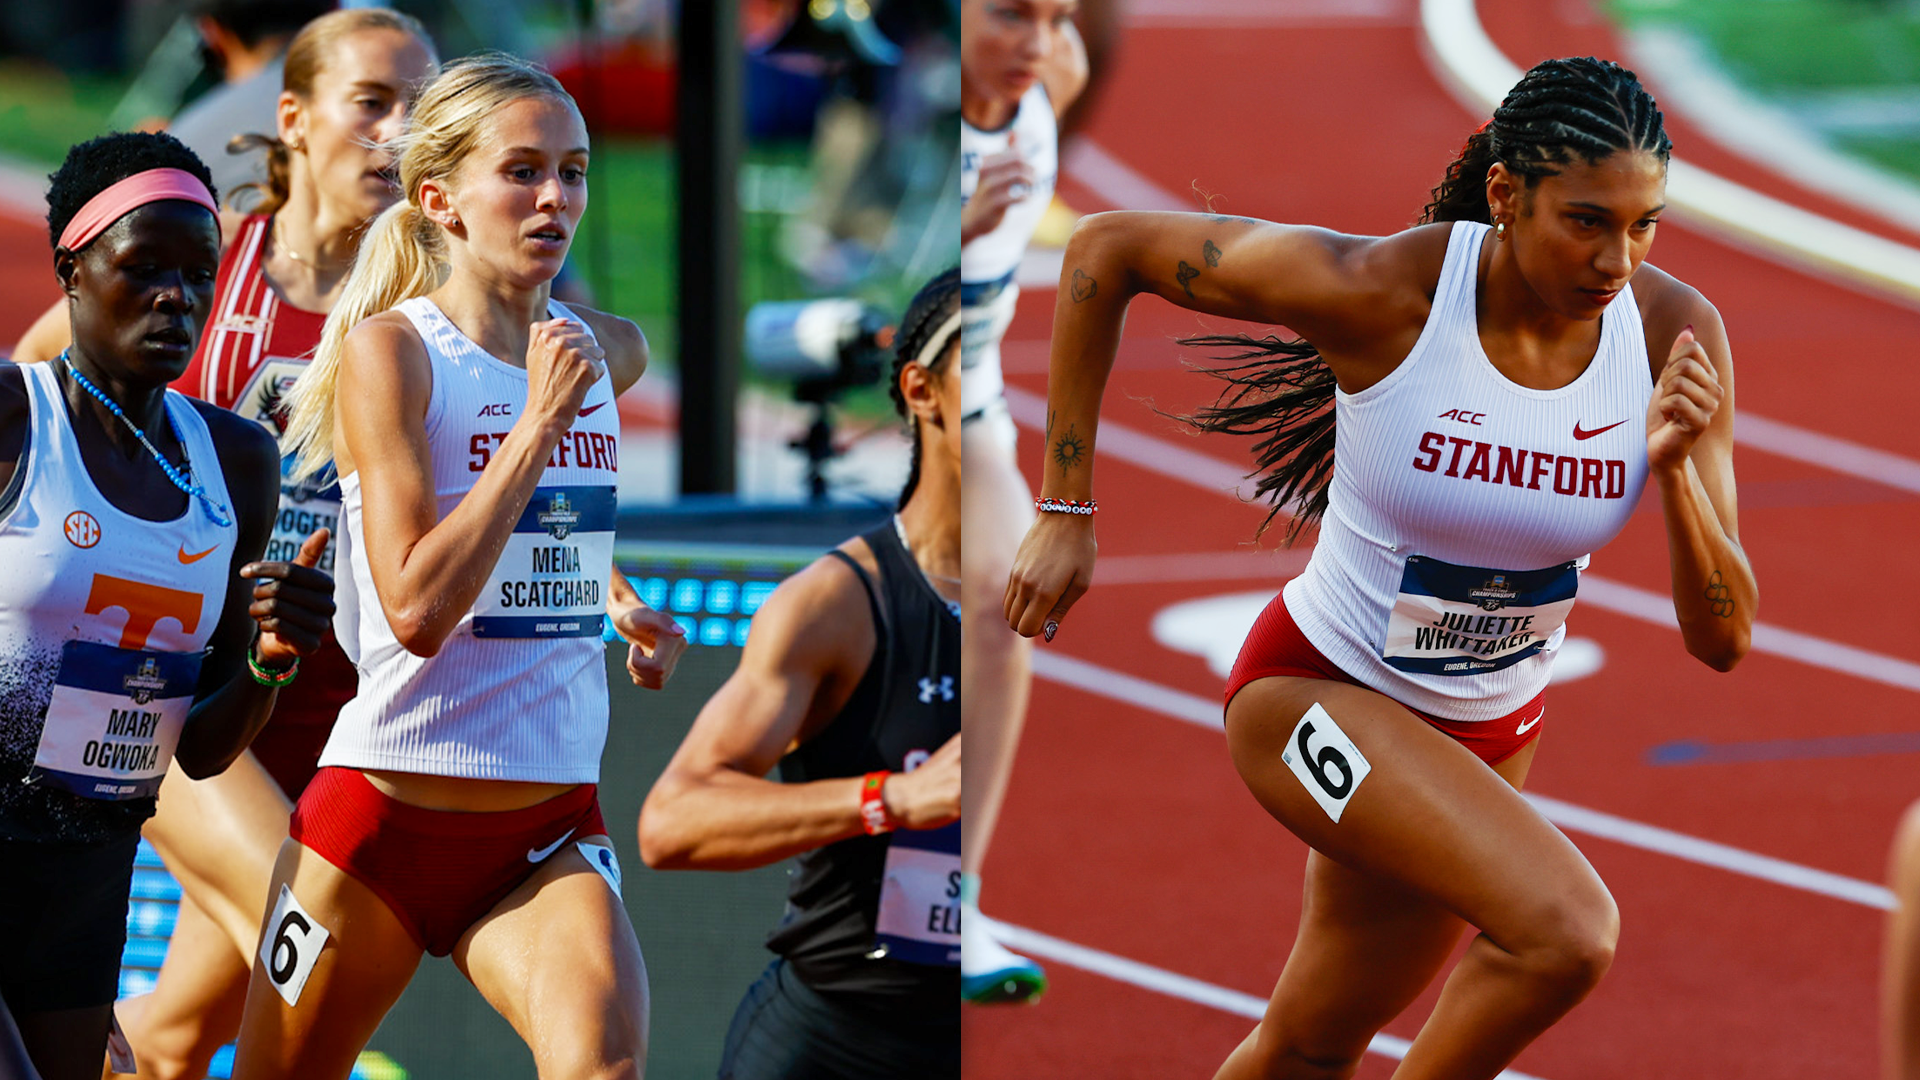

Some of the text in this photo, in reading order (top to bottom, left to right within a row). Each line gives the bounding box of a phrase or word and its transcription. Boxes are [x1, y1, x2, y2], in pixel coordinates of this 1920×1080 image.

[477, 403, 512, 418] ACC
[1437, 408, 1487, 426] ACC
[1412, 431, 1626, 499] STANFORD
[65, 511, 101, 548] SEC
[532, 546, 581, 573] MENA
[500, 580, 599, 608] SCATCHARD
[1432, 611, 1535, 635] JULIETTE
[1415, 627, 1535, 655] WHITTAKER
[106, 708, 162, 738] MARY
[82, 740, 159, 771] OGWOKA
[1297, 720, 1353, 800] 6
[270, 910, 311, 985] 6
